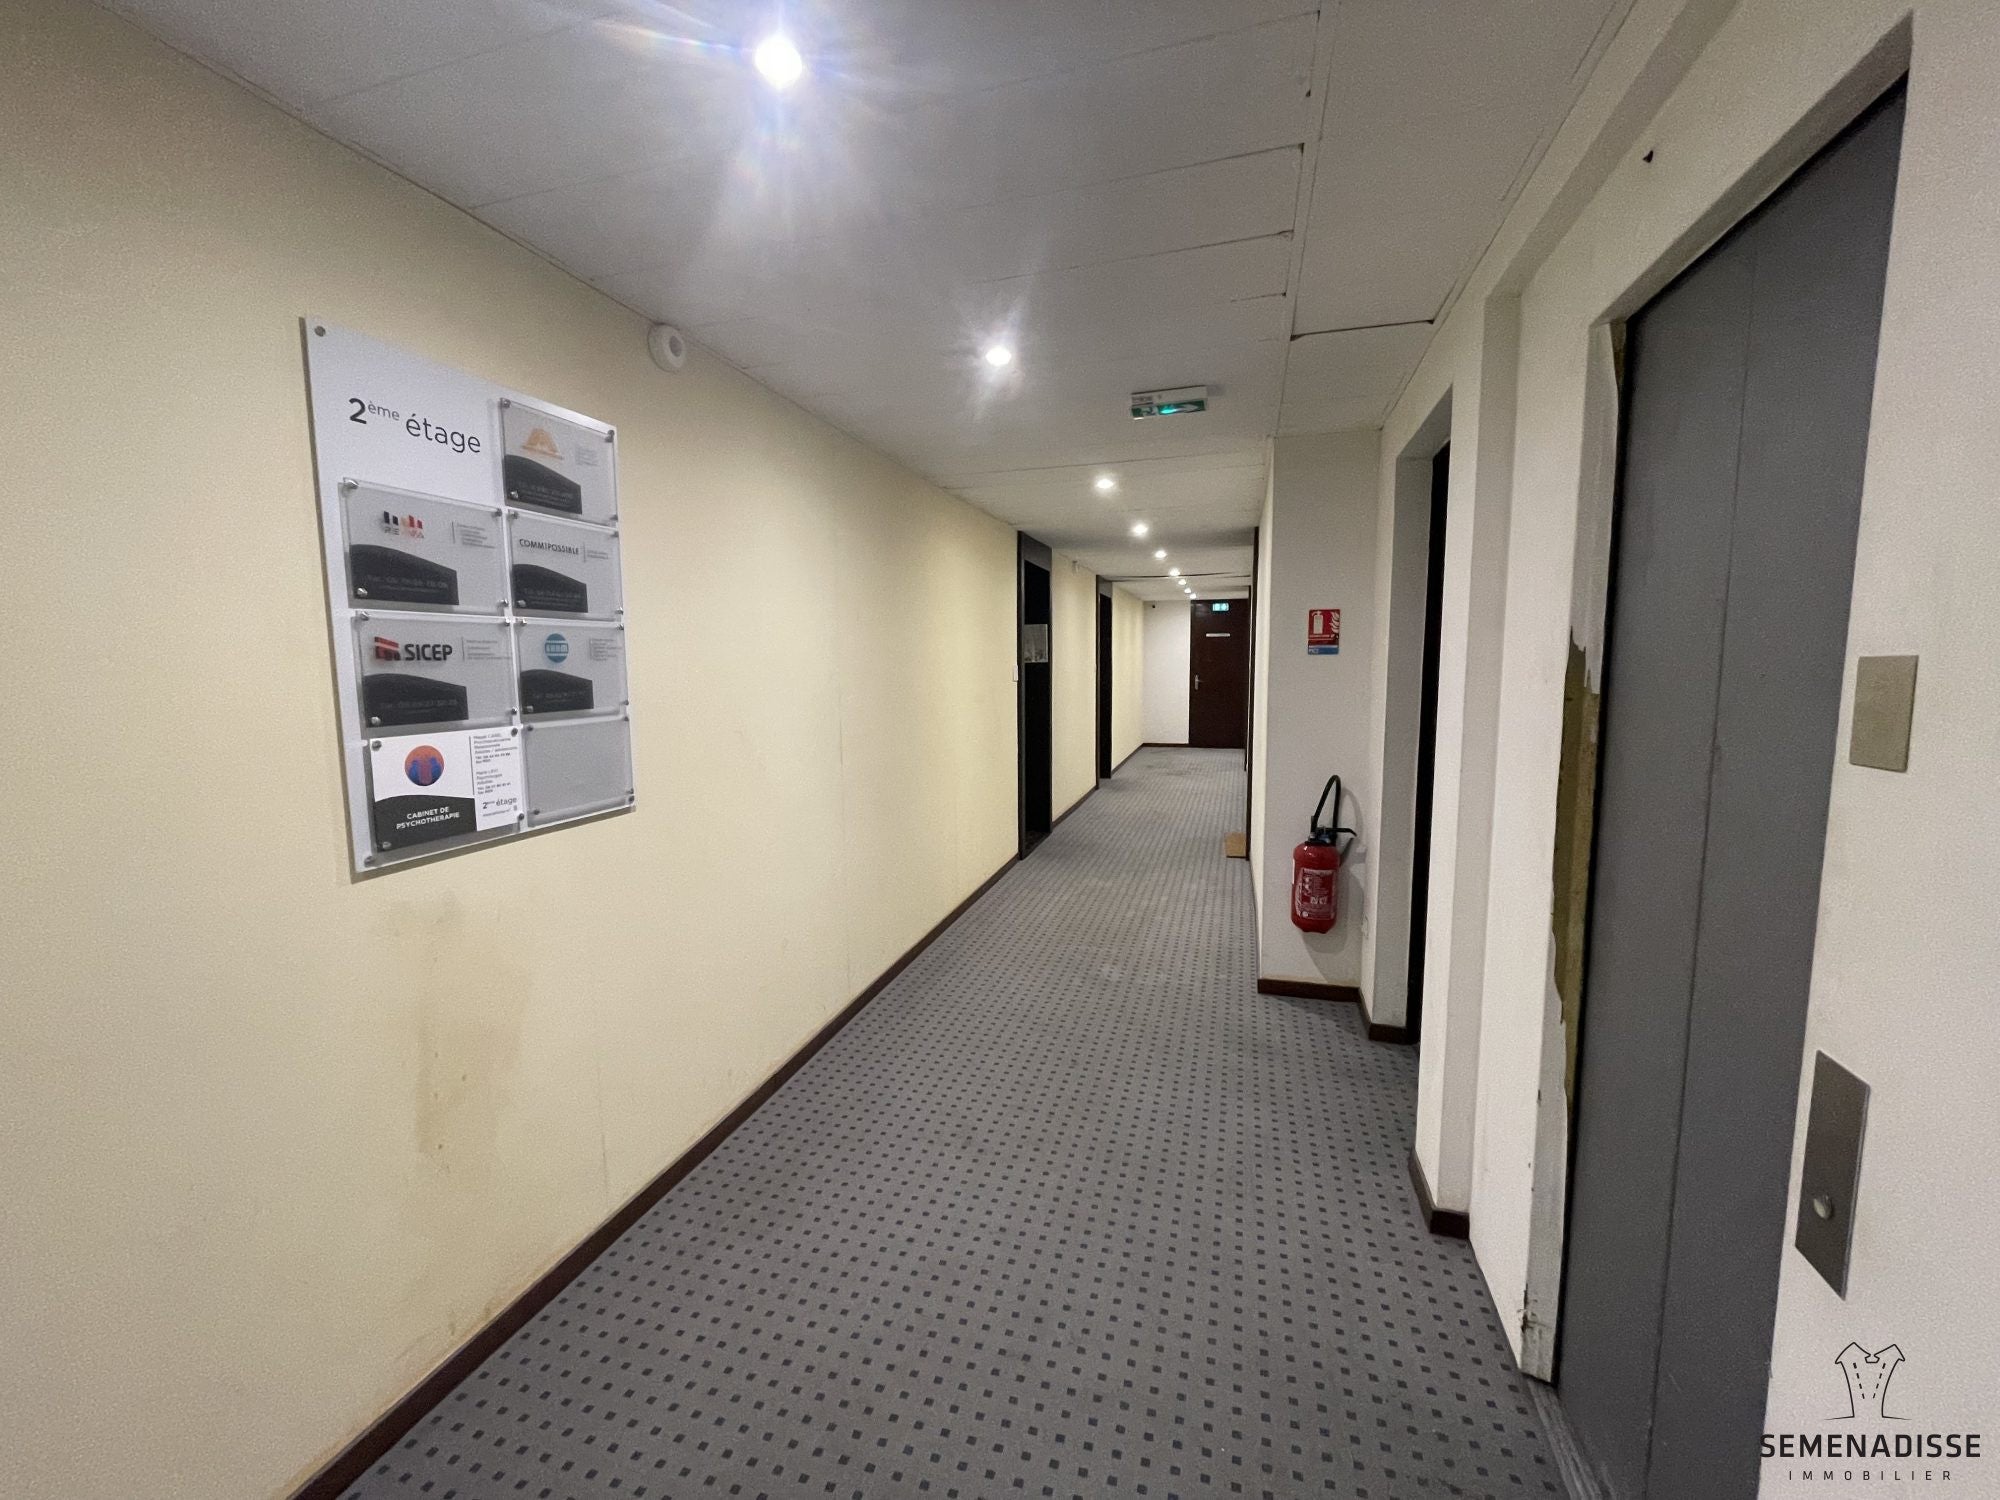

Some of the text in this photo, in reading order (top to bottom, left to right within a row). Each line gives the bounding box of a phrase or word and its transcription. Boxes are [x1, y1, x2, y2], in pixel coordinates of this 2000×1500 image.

[349, 398, 481, 453] 2ème étage
[404, 643, 453, 661] SICEP
[396, 811, 460, 830] PSYCHOTHERAPIE
[406, 806, 450, 820] CABINET DE
